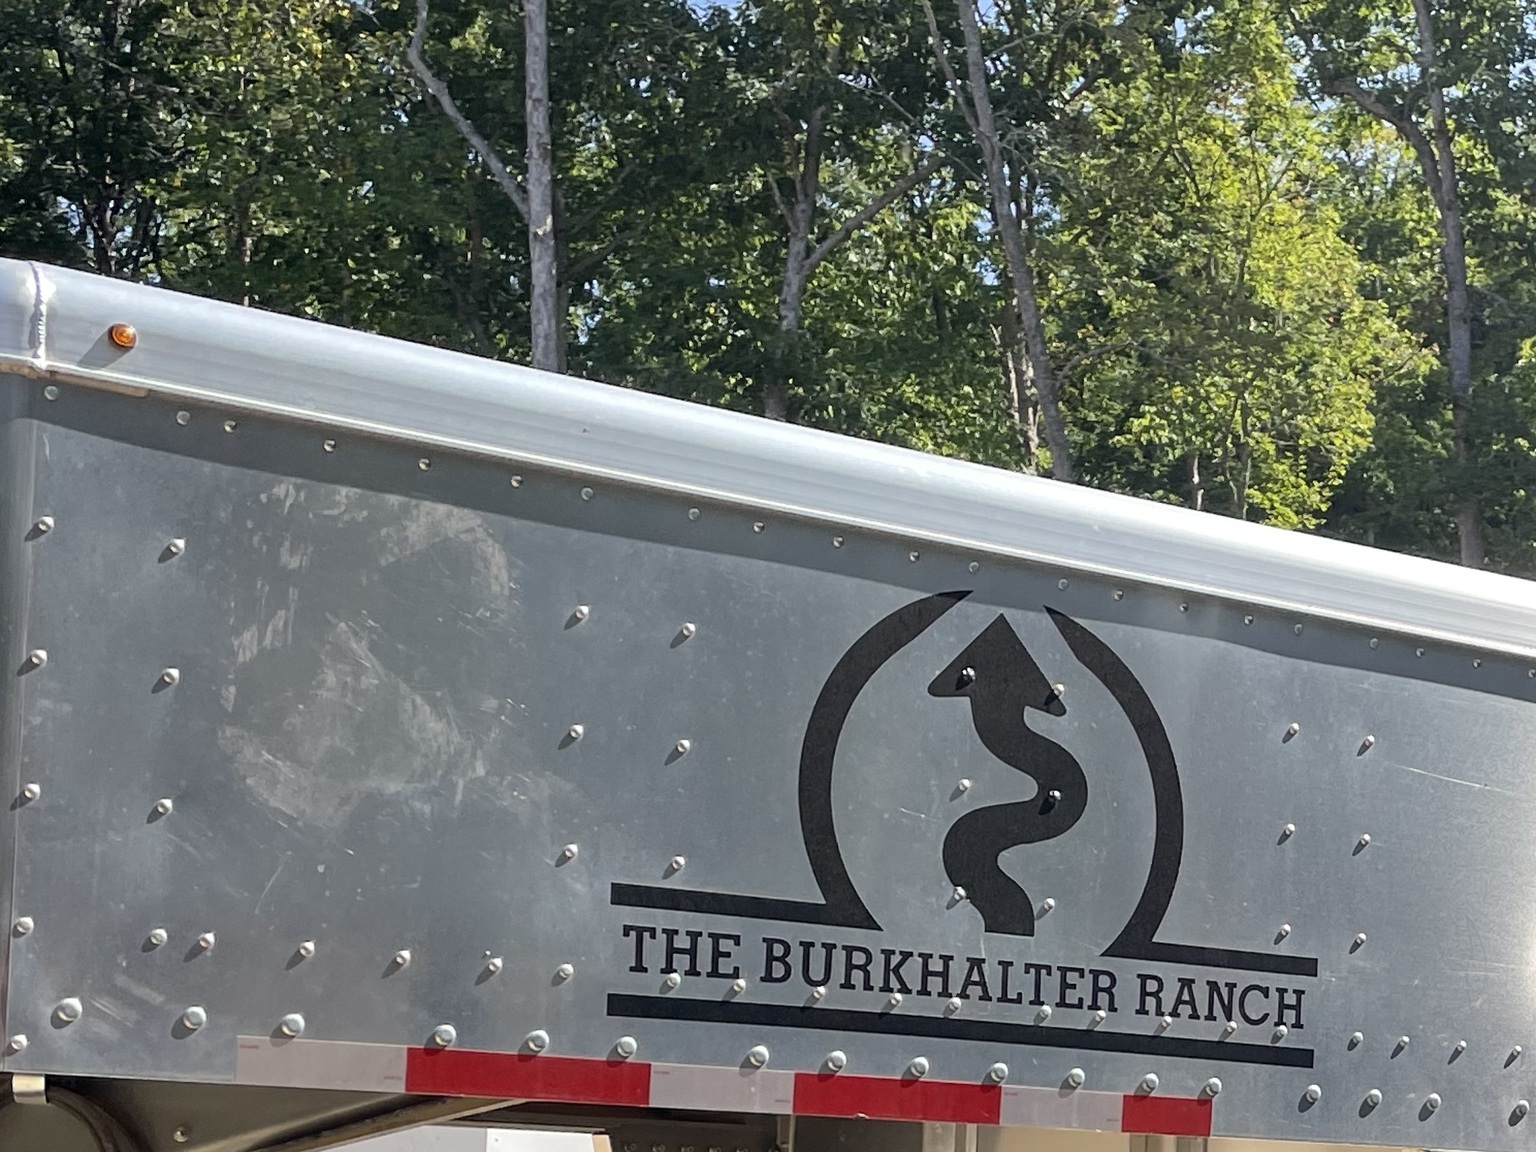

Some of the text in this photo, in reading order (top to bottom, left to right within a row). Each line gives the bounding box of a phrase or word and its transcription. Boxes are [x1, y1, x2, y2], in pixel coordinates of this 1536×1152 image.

[622, 924, 1306, 1029] THE BURKHALTER RANCH
